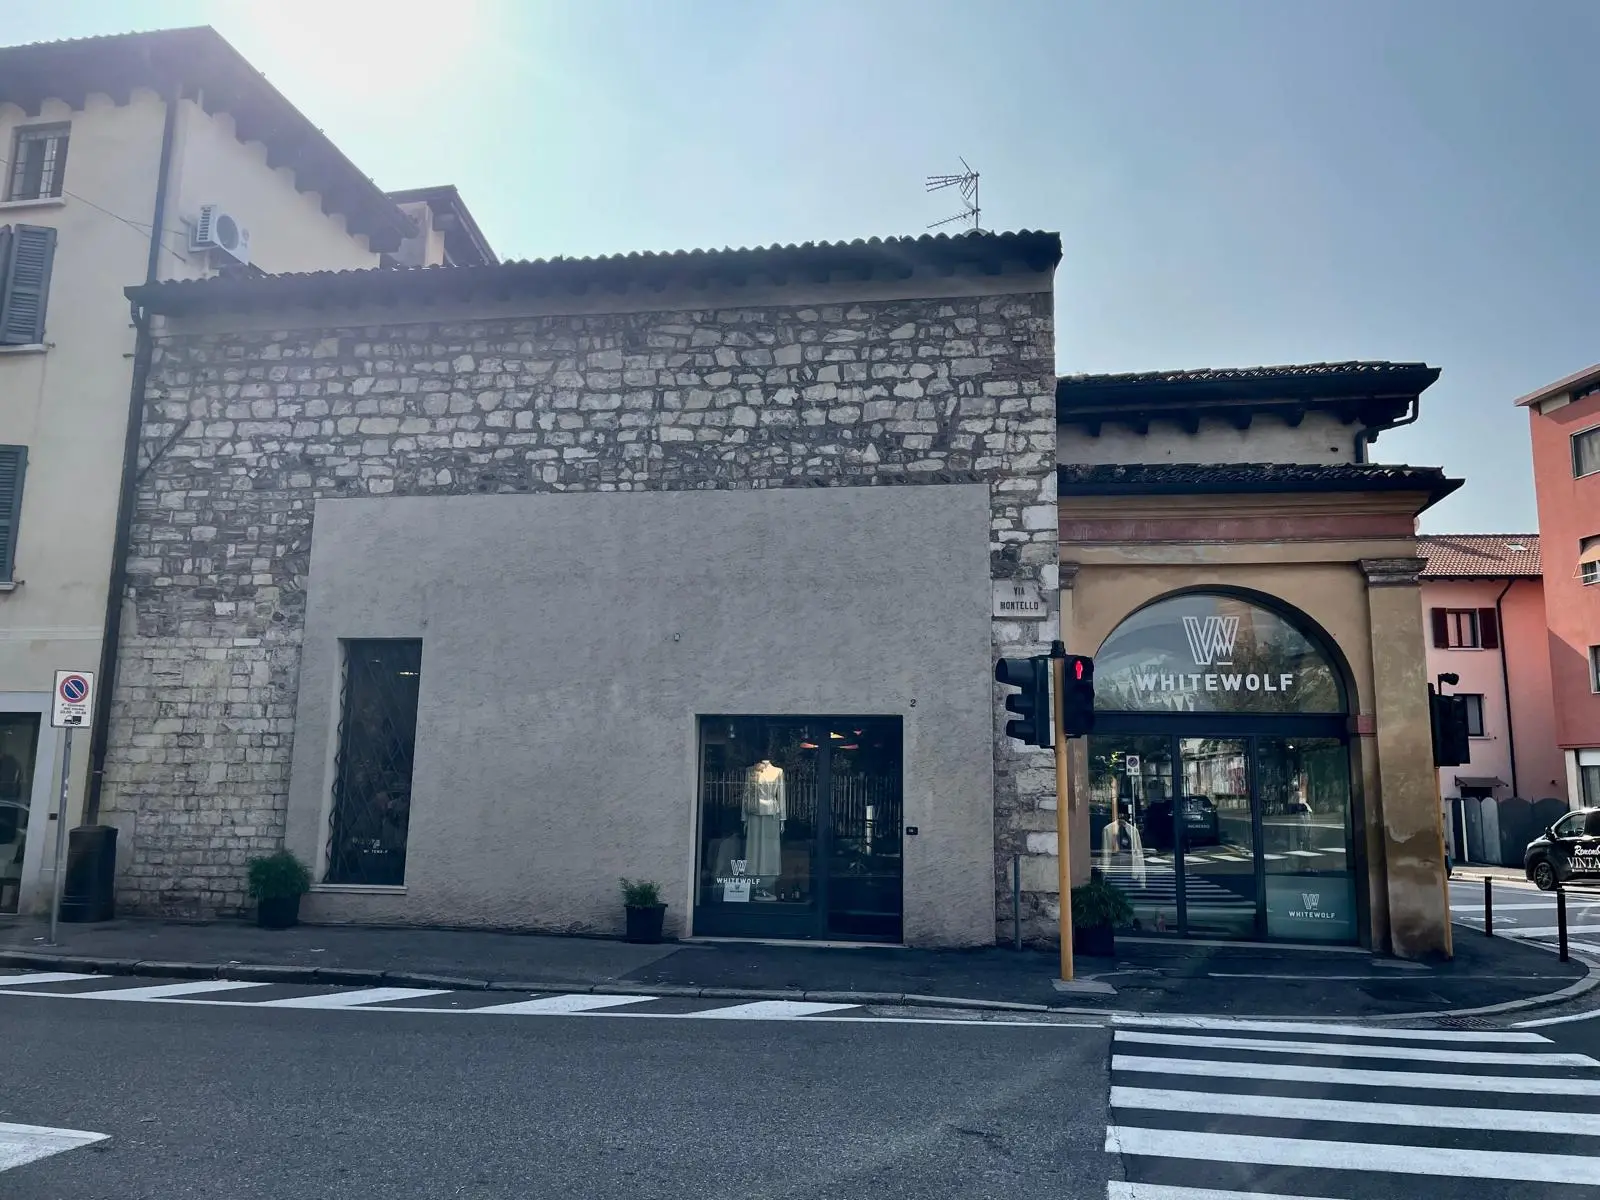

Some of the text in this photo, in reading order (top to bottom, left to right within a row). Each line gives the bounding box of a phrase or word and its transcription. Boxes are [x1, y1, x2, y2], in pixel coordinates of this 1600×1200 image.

[1013, 586, 1025, 596] VIA
[1000, 601, 1039, 610] MONTELLO
[1135, 673, 1294, 692] WHITEWOLF
[910, 698, 916, 708] 2
[716, 877, 761, 885] WHITEWOLF
[1288, 910, 1336, 919] WHITEWOLF
